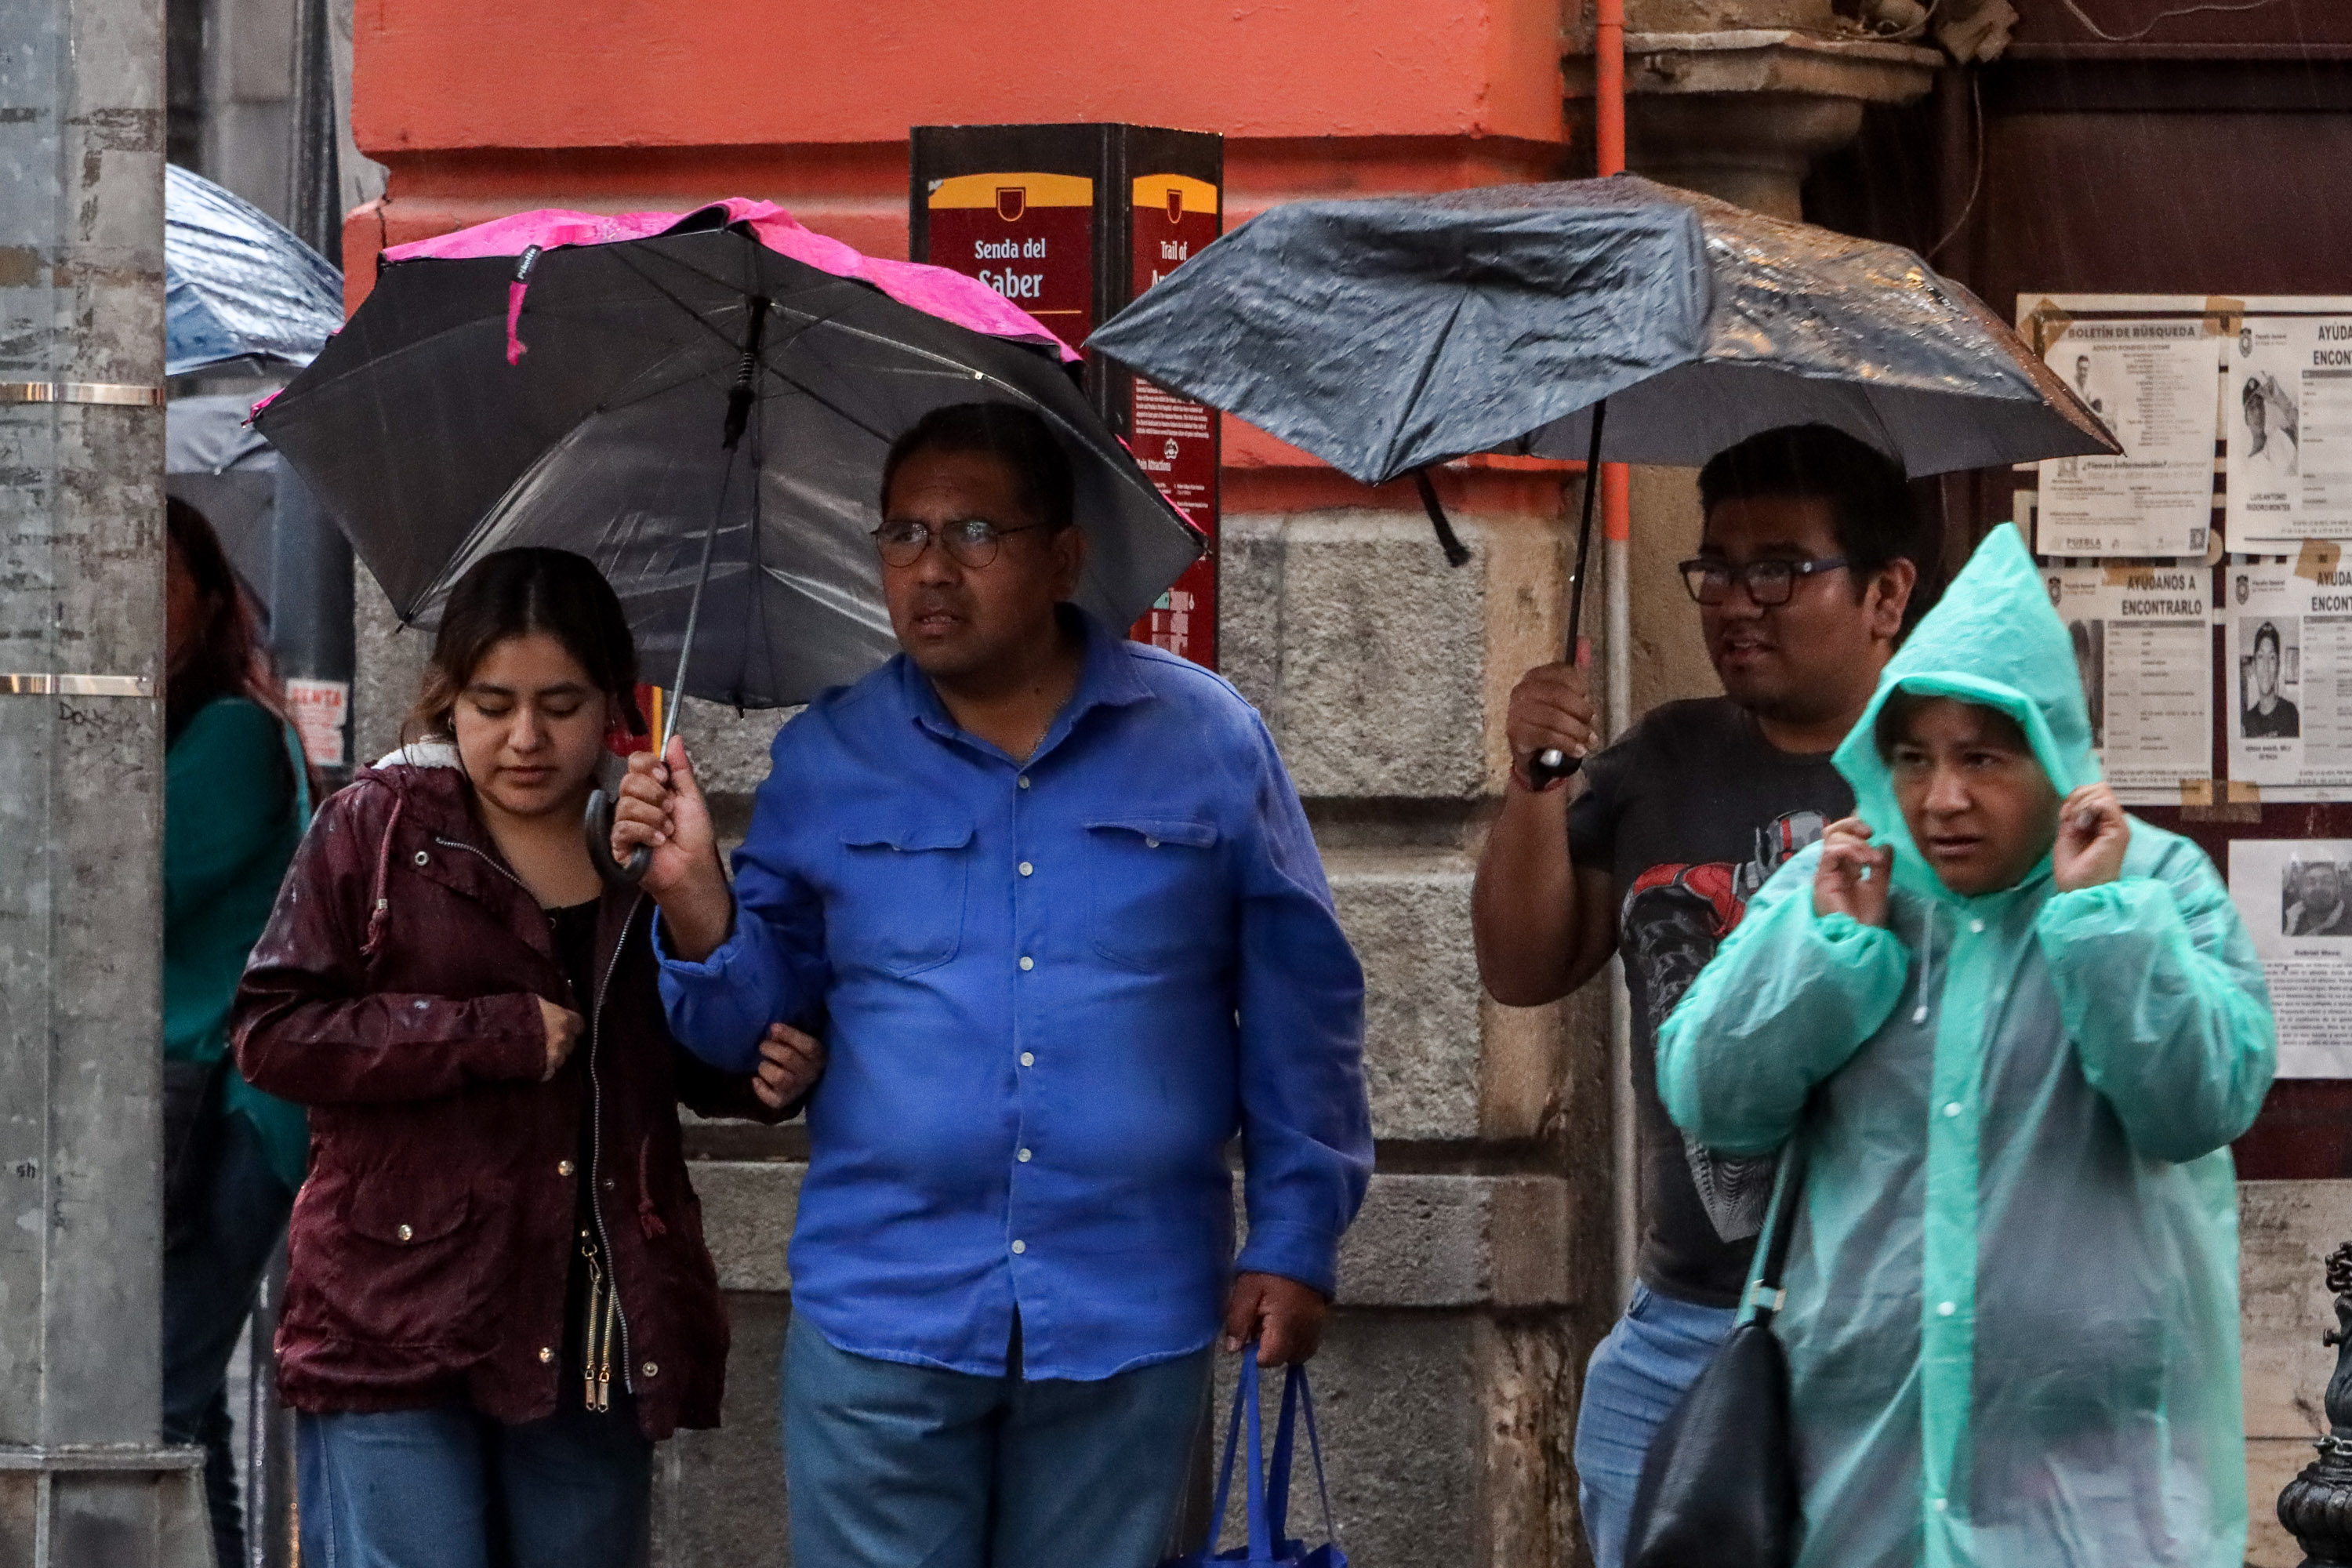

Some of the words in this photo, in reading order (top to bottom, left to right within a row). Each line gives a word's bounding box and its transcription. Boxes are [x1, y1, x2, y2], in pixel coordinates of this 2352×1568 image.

[975, 238, 1019, 260] Senda
[1023, 238, 1046, 259] del
[1160, 240, 1178, 260] Trail
[1178, 241, 1188, 261] of
[2068, 325, 2114, 338] BOLETÍN
[2116, 326, 2130, 338] DE
[2132, 325, 2195, 339] BÚSQUEDA
[2189, 575, 2196, 590] A
[2122, 599, 2203, 615] ENCONTRARLO
